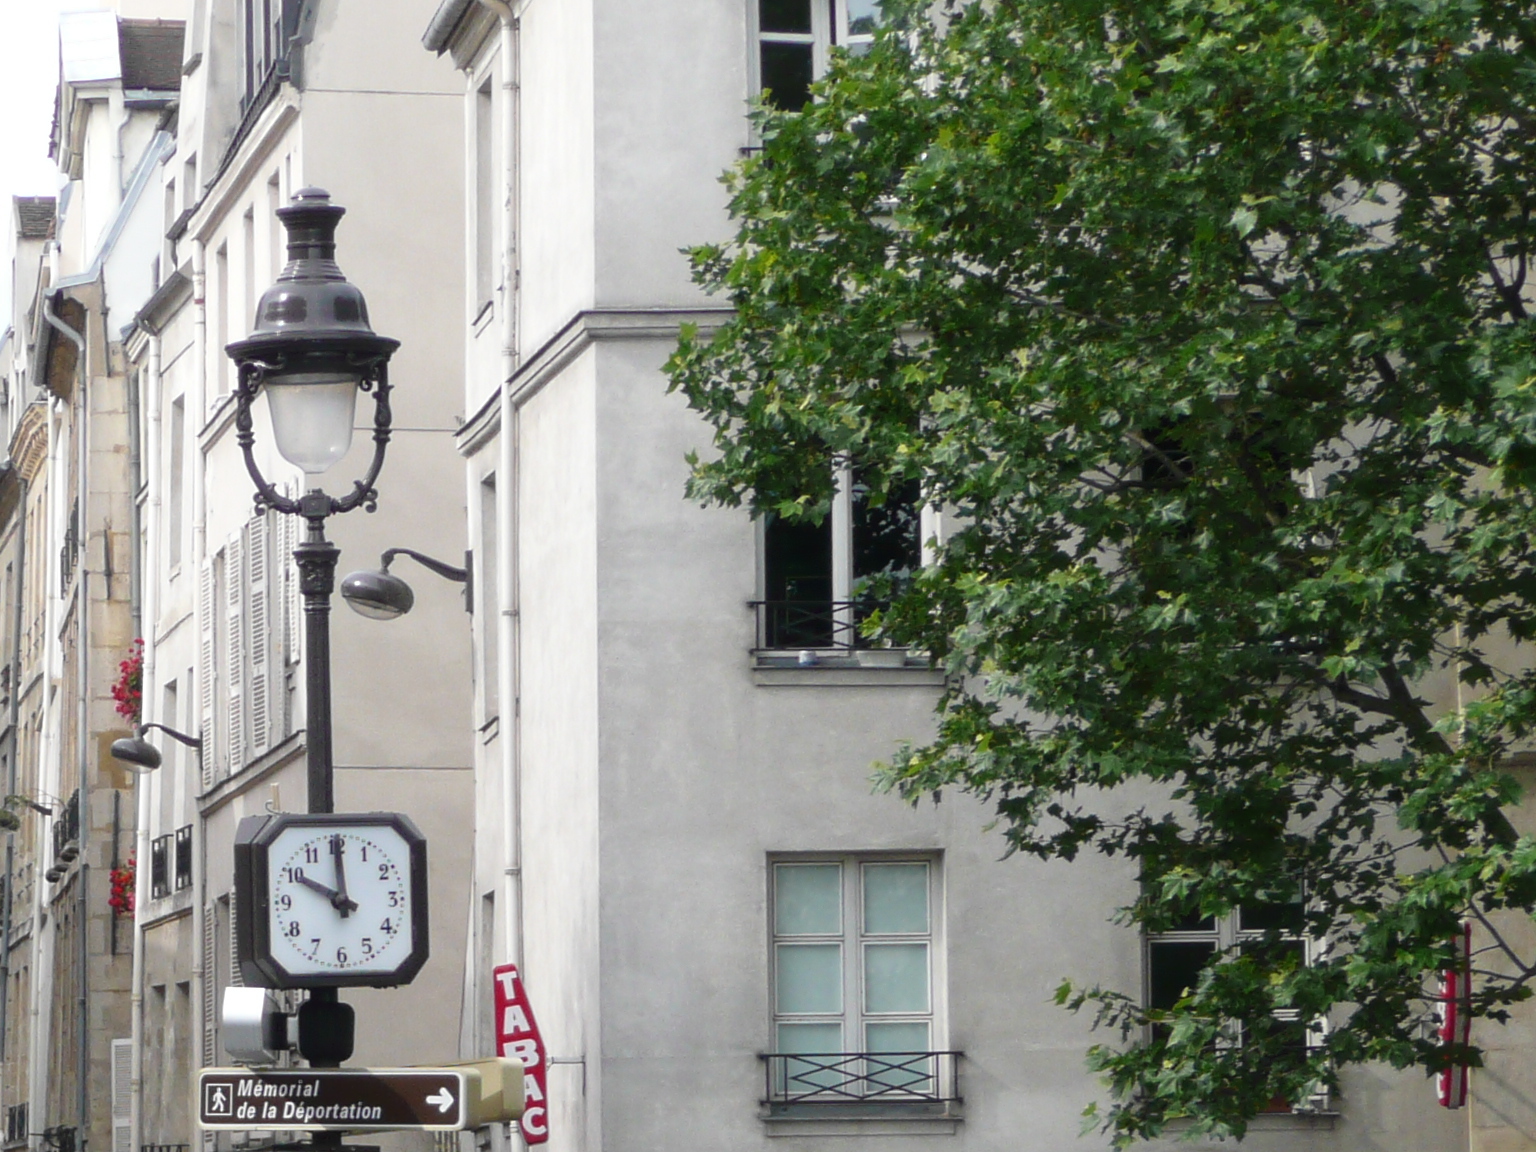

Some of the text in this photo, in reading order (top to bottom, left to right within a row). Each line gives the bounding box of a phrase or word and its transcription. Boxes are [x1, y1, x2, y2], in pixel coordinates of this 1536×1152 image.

[305, 847, 318, 863] 11
[361, 847, 367, 862] 1
[287, 867, 304, 883] 10
[379, 864, 389, 880] 2
[281, 895, 291, 911] 9
[388, 891, 398, 907] 3
[289, 921, 300, 937] 8
[380, 918, 392, 934] 4
[311, 939, 321, 955] 7
[362, 938, 372, 954] 5
[337, 947, 347, 963] 6
[496, 971, 547, 1136] TABAC
[237, 1079, 320, 1097] Mémorial
[237, 1101, 381, 1122] de la Déportation
